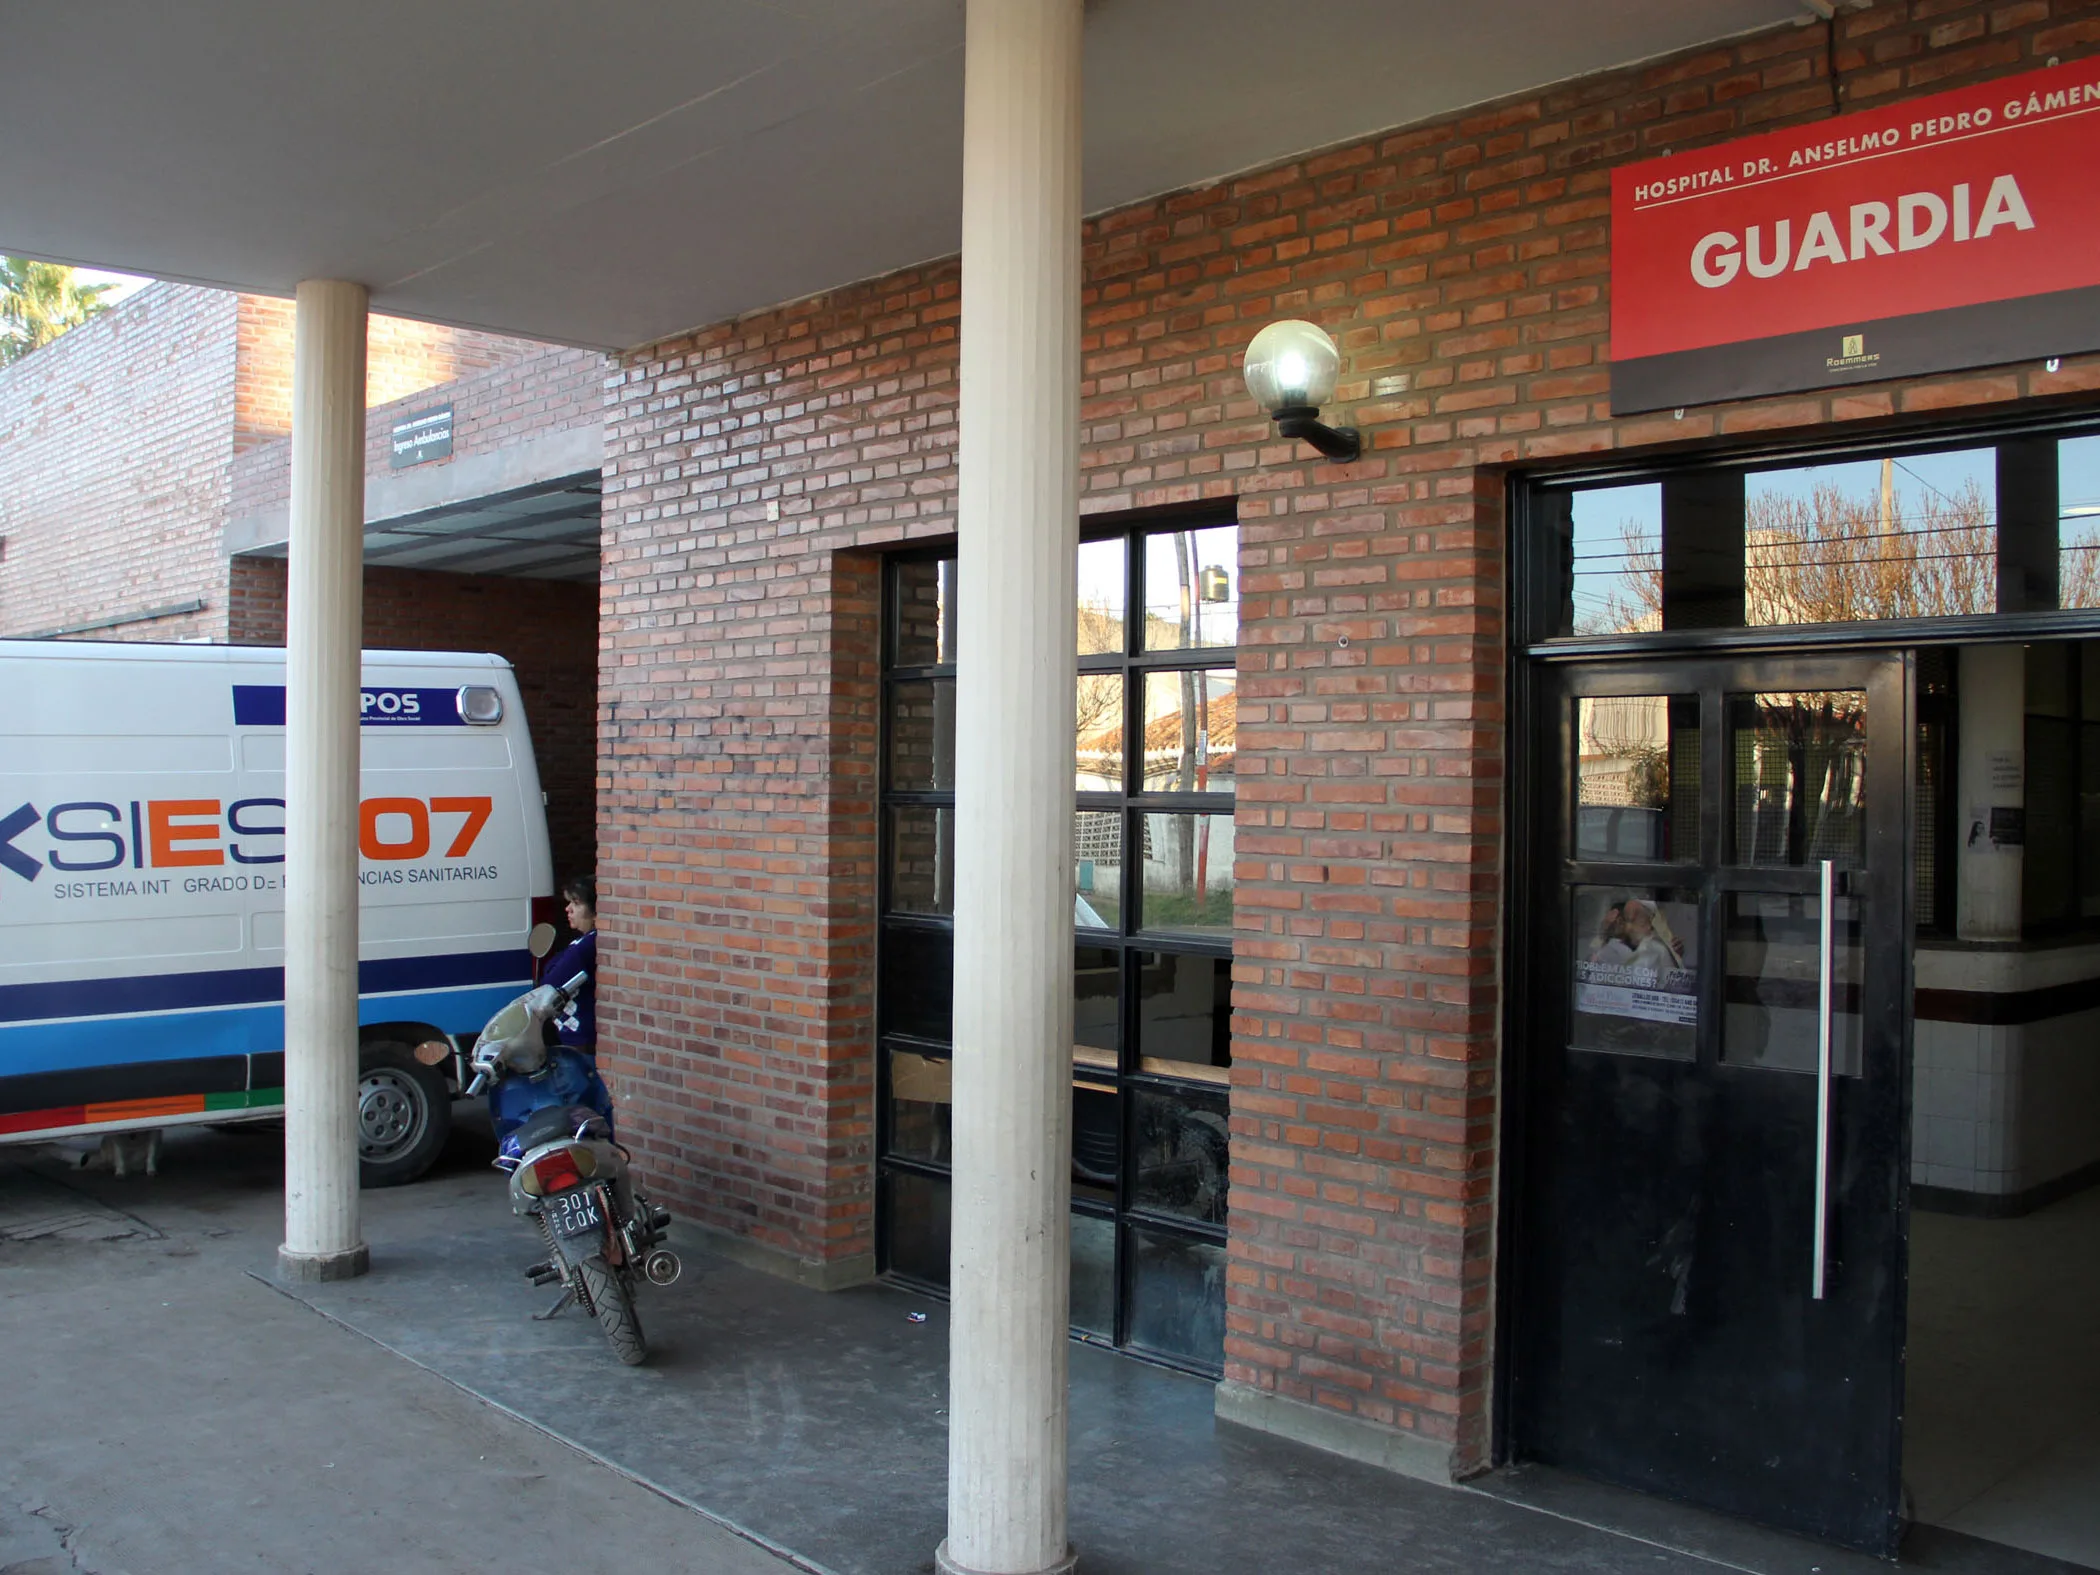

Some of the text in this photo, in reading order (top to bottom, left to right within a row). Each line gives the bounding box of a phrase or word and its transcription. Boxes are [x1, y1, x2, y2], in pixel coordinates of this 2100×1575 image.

[1634, 166, 1734, 202] HOSPITAL
[1743, 157, 1779, 178] DR.
[1788, 127, 1900, 168] ANSELMO
[1910, 107, 1993, 141] PEDRO
[1689, 173, 2035, 289] GUARDIA
[360, 692, 420, 714] POS
[359, 796, 493, 860] 07
[54, 881, 137, 899] SISTEMA
[408, 865, 498, 883] SANITARIAS
[559, 1191, 591, 1215] 301
